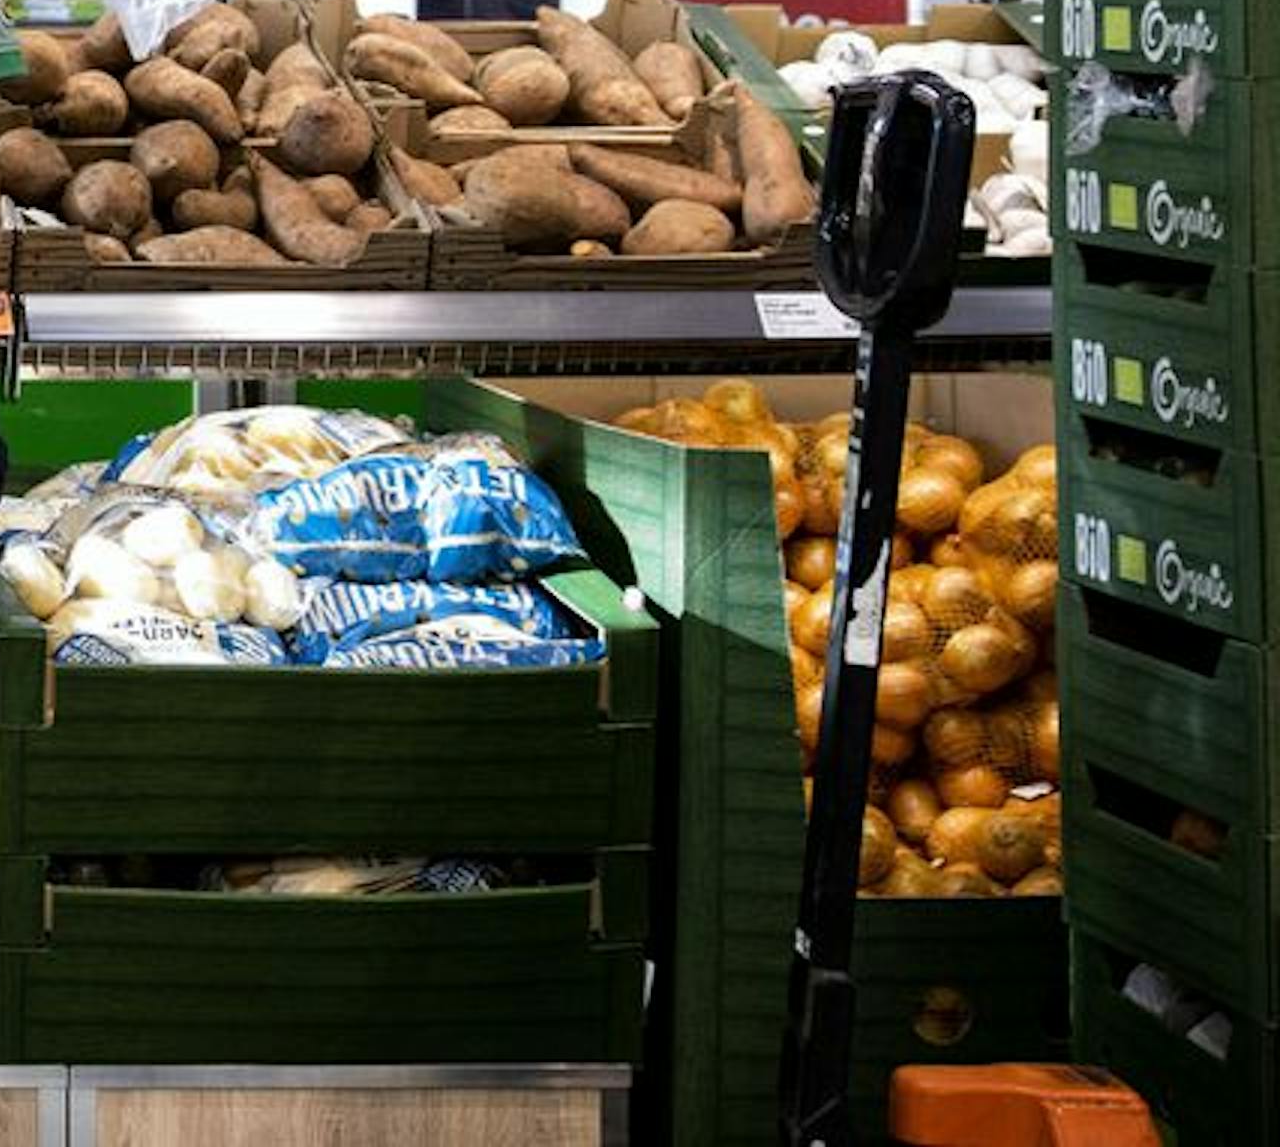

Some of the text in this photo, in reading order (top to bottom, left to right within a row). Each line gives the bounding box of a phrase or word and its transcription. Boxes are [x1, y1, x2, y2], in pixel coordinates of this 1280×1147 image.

[1146, 179, 1224, 247] Organic
[1151, 356, 1228, 428] Organic
[1156, 539, 1233, 611] Organic
